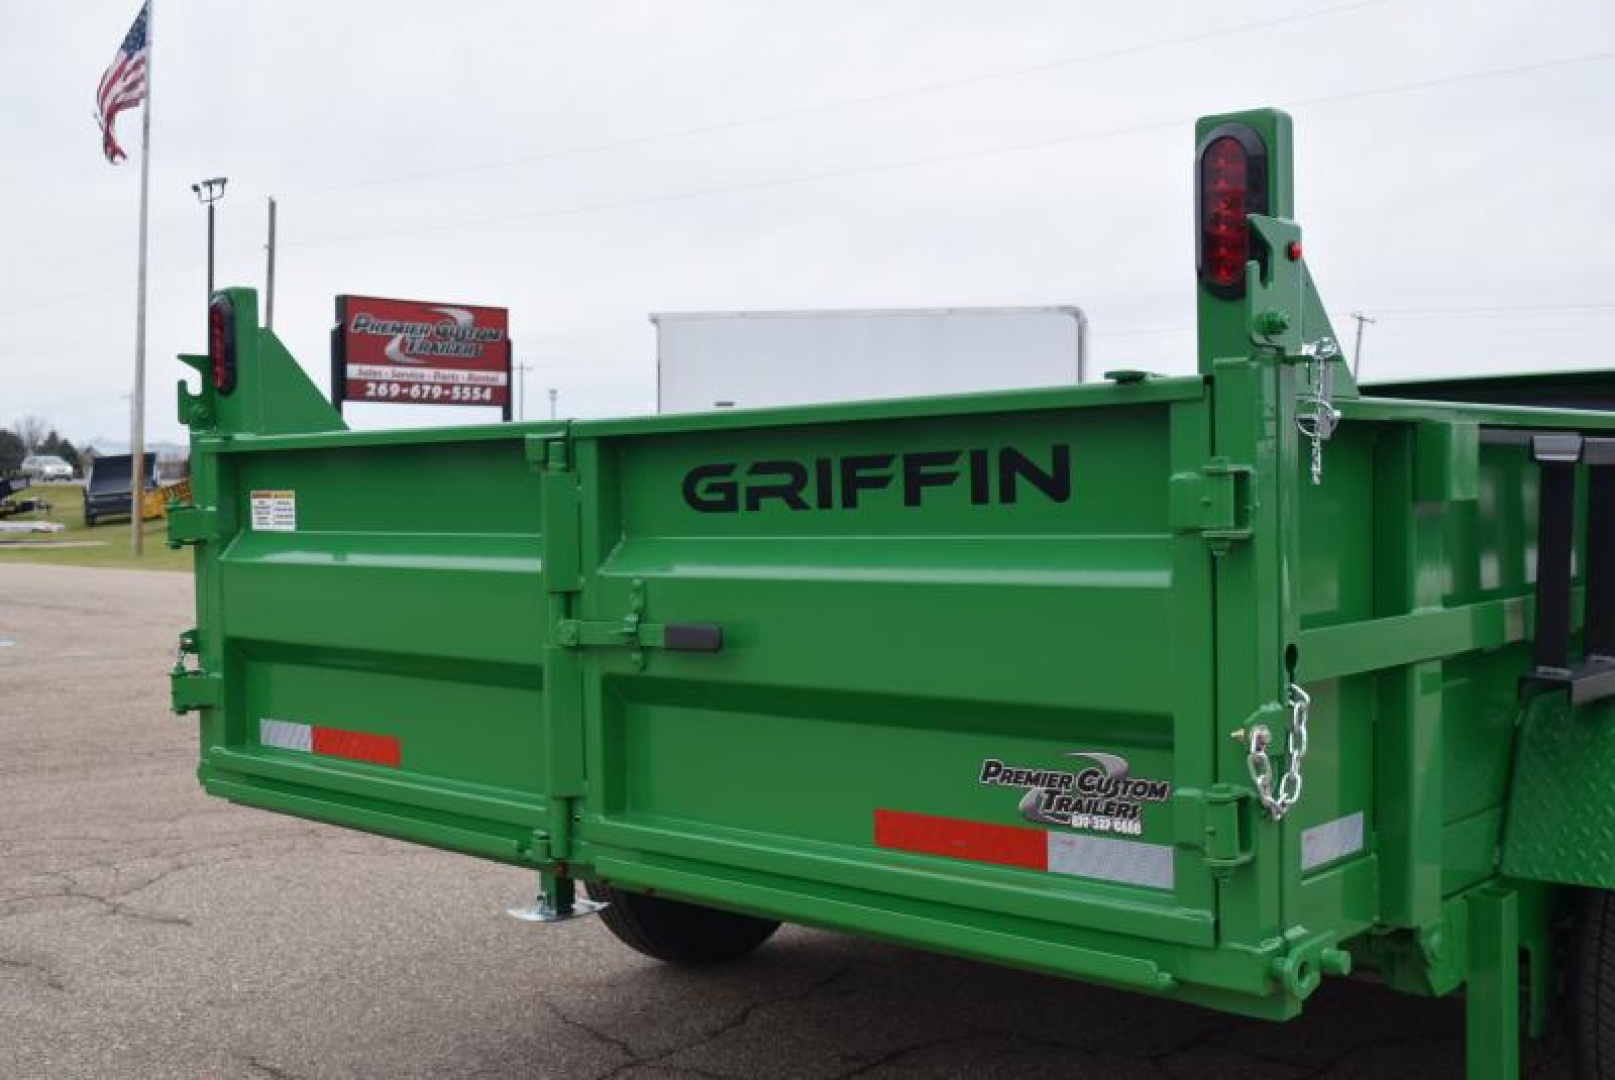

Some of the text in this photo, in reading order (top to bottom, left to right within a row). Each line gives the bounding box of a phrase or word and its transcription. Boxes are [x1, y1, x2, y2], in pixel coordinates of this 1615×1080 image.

[366, 382, 492, 399] 269-679-5554
[682, 444, 1071, 513] GRIFFIN
[980, 759, 1169, 800] PREMIER CUSTOM
[1042, 789, 1141, 818] TRAILERS
